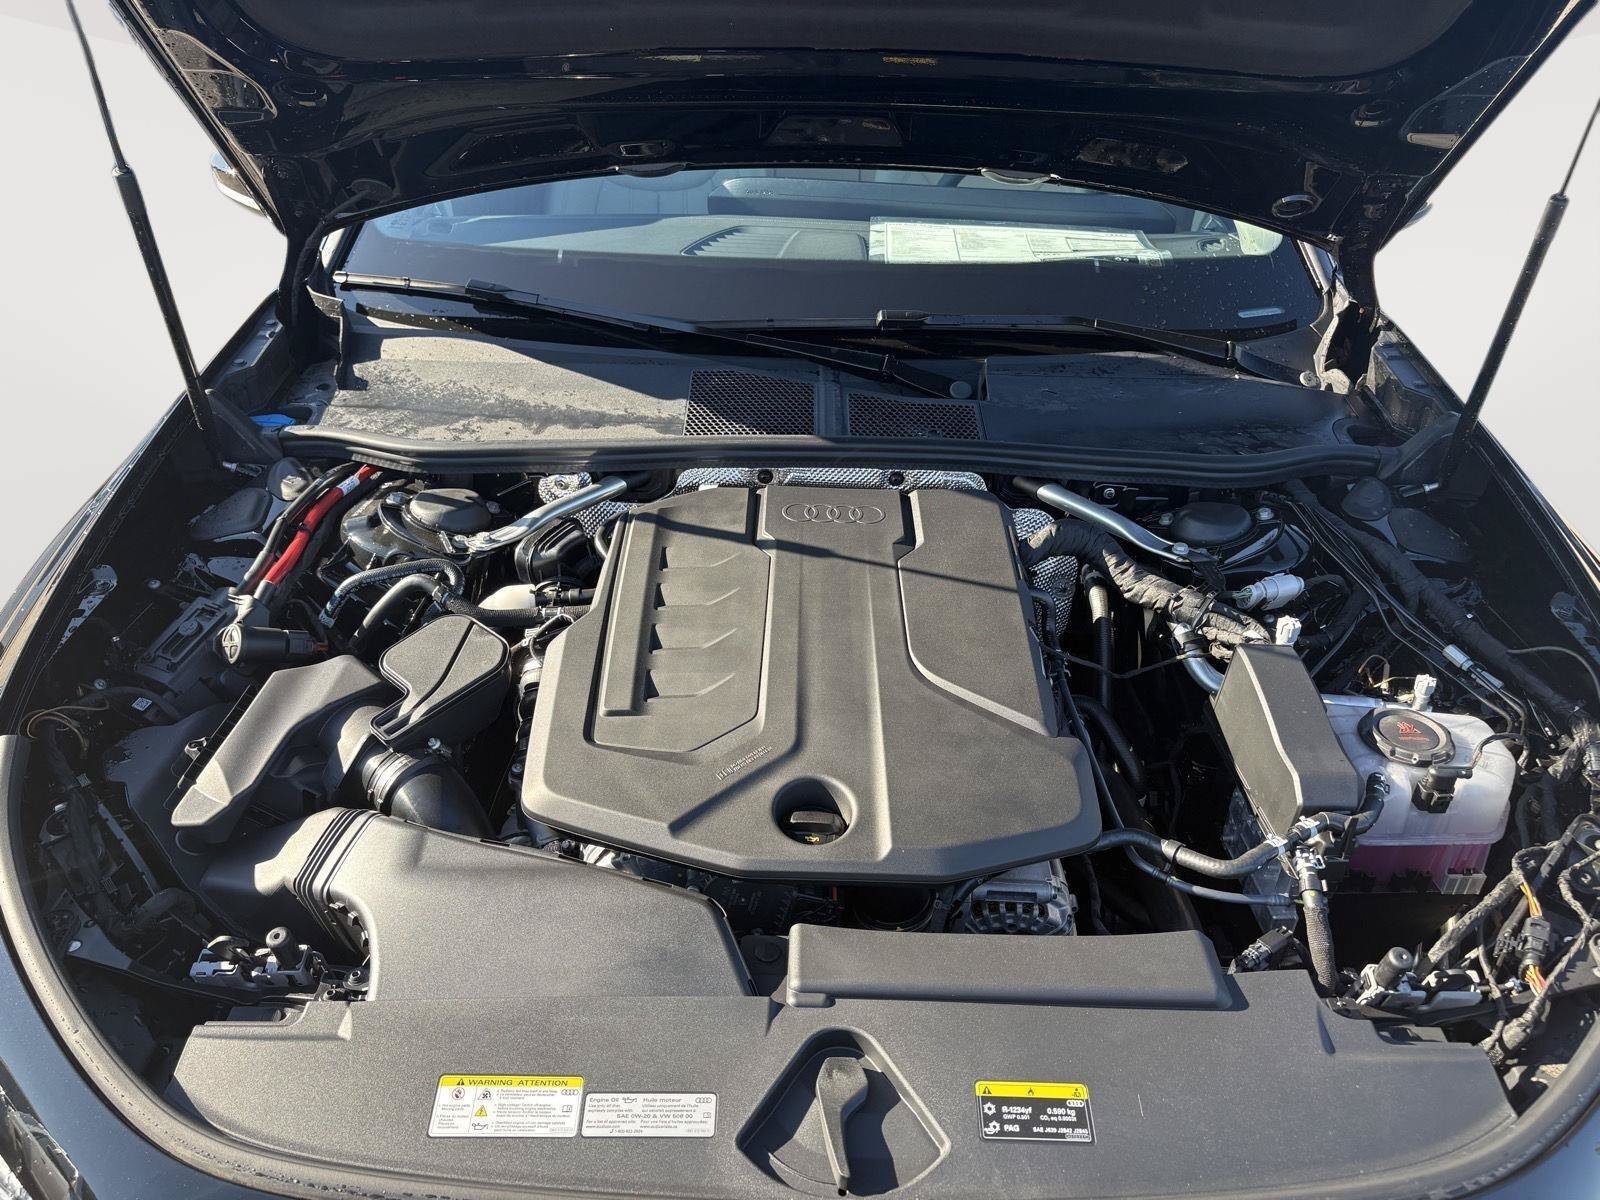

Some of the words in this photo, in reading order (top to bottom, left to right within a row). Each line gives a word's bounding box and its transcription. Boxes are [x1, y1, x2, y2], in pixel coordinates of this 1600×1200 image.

[517, 1079, 568, 1087] ATTENTION
[1002, 1106, 1032, 1114] R-1234yf
[1066, 1108, 1076, 1117] kg
[1004, 1124, 1020, 1132] PAG
